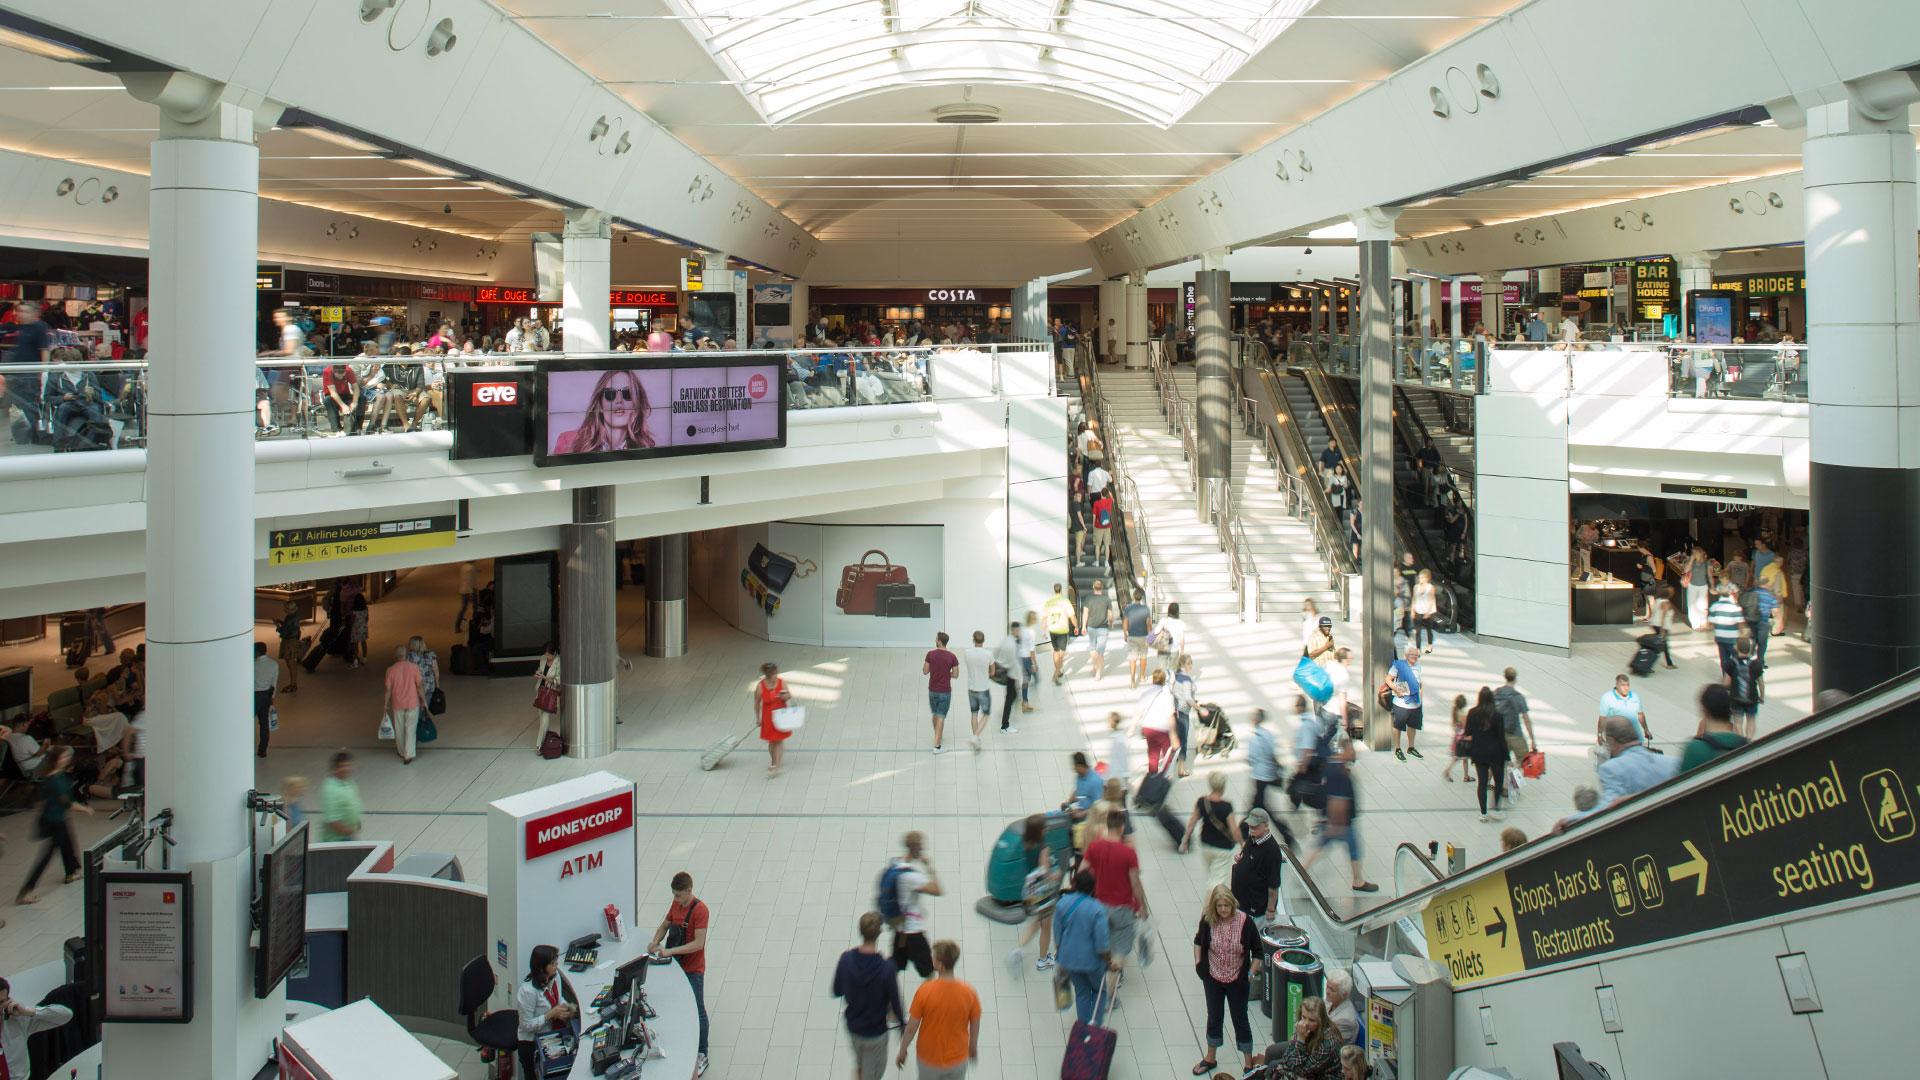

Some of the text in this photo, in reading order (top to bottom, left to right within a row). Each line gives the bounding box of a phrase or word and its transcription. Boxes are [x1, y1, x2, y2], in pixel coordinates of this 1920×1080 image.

[1637, 266, 1669, 278] BAR
[1636, 281, 1670, 289] EATING
[1748, 277, 1795, 293] BRIDGE
[627, 293, 666, 303] ROUGE
[928, 289, 976, 302] COSTA
[1636, 289, 1670, 297] HOUSE
[680, 387, 716, 401] GATWICK'S
[717, 386, 746, 399] HOTTEST
[673, 398, 752, 414] SUNGLASS DESTINATION
[1690, 486, 1708, 494] Gates
[306, 527, 378, 542] Airline lounges
[335, 544, 368, 555] Toilets
[1720, 760, 1847, 843] Additional
[538, 807, 623, 844] MONEYCORP
[560, 850, 603, 880] ATM
[1772, 843, 1874, 897] seating
[1513, 859, 1602, 916] Shops, bars &
[1532, 916, 1615, 960] Restaurants
[1444, 948, 1484, 980] Toilets
